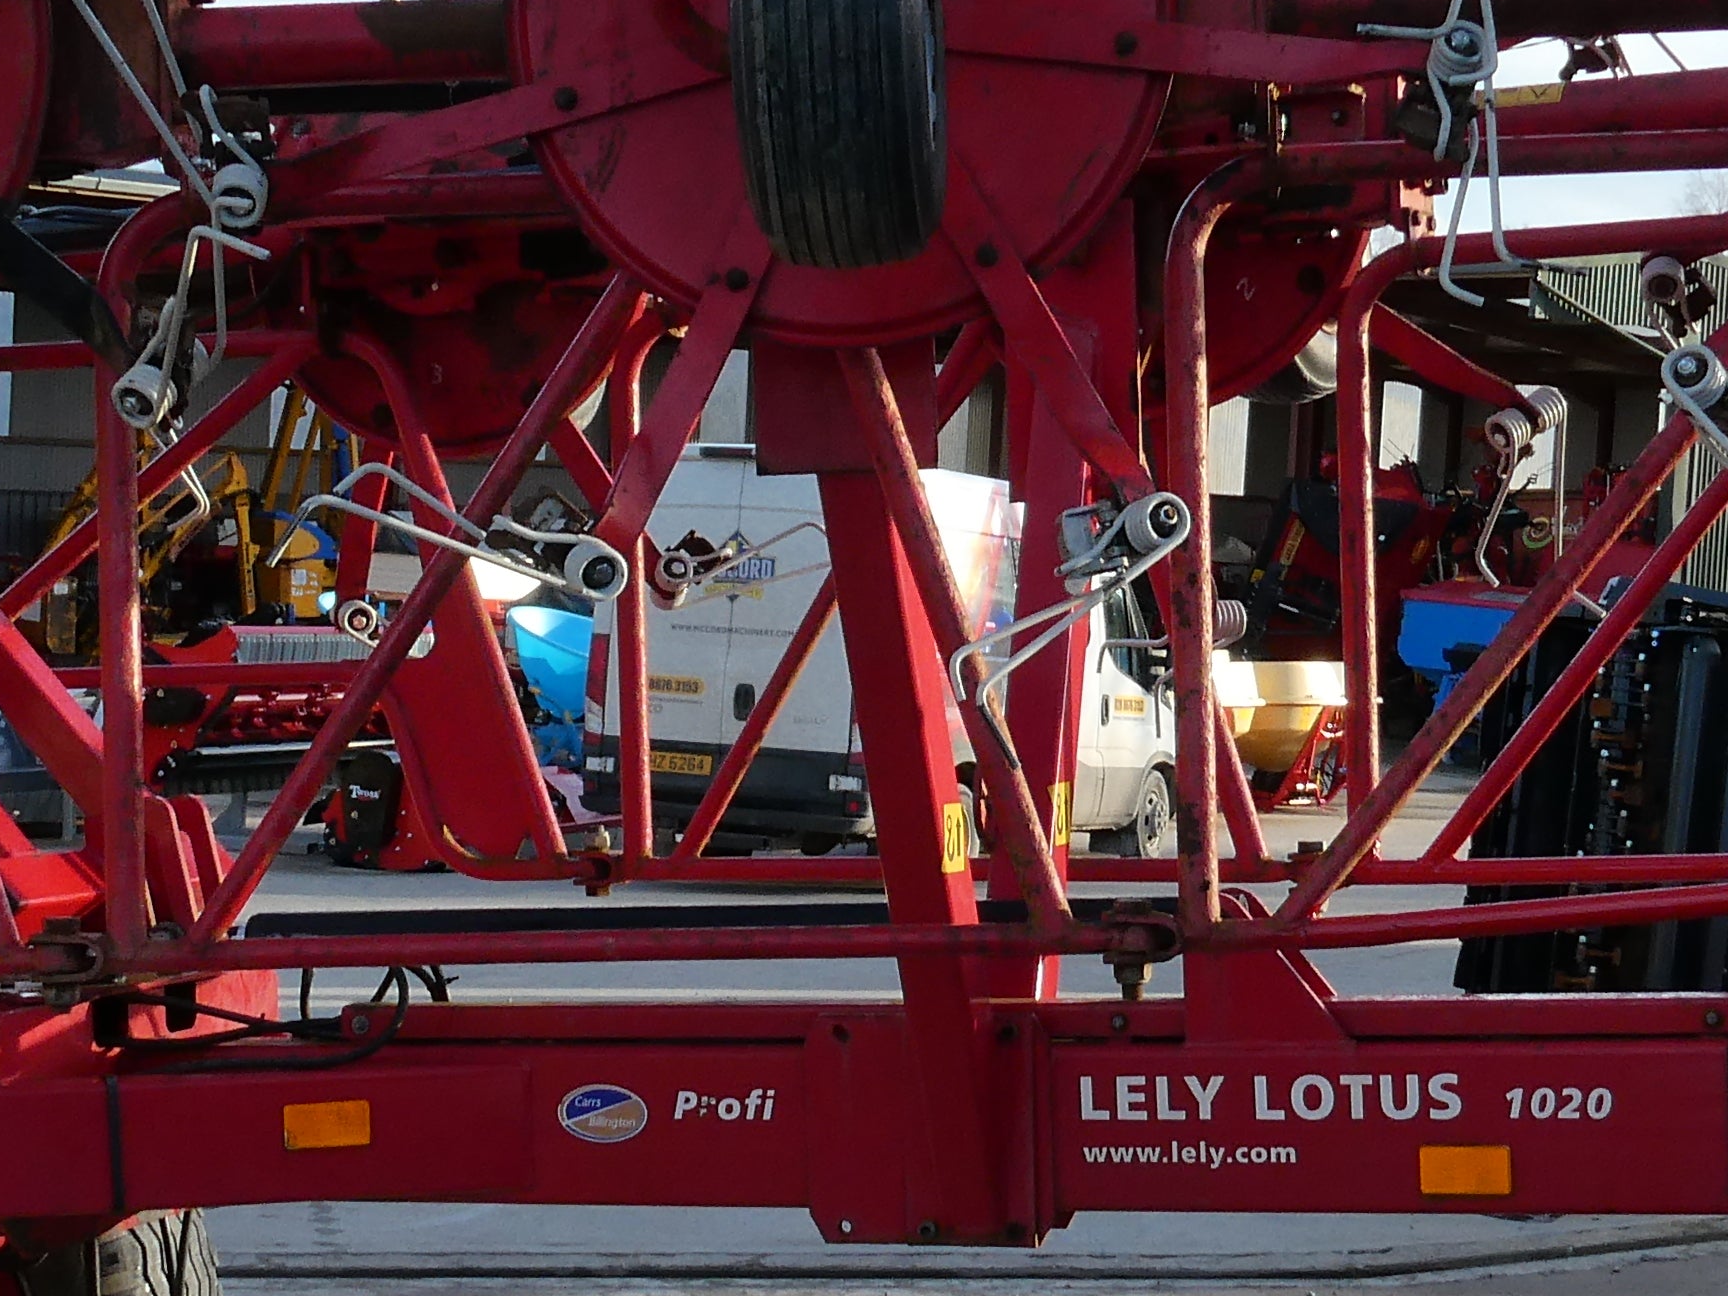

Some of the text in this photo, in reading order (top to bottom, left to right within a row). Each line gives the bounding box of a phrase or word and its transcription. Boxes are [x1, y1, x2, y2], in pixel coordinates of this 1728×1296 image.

[574, 1094, 602, 1108] Carrs
[1080, 1073, 1612, 1120] LELY LOTUS 1020
[588, 1115, 637, 1130] Billington
[1083, 1140, 1297, 1169] www.lely.com
